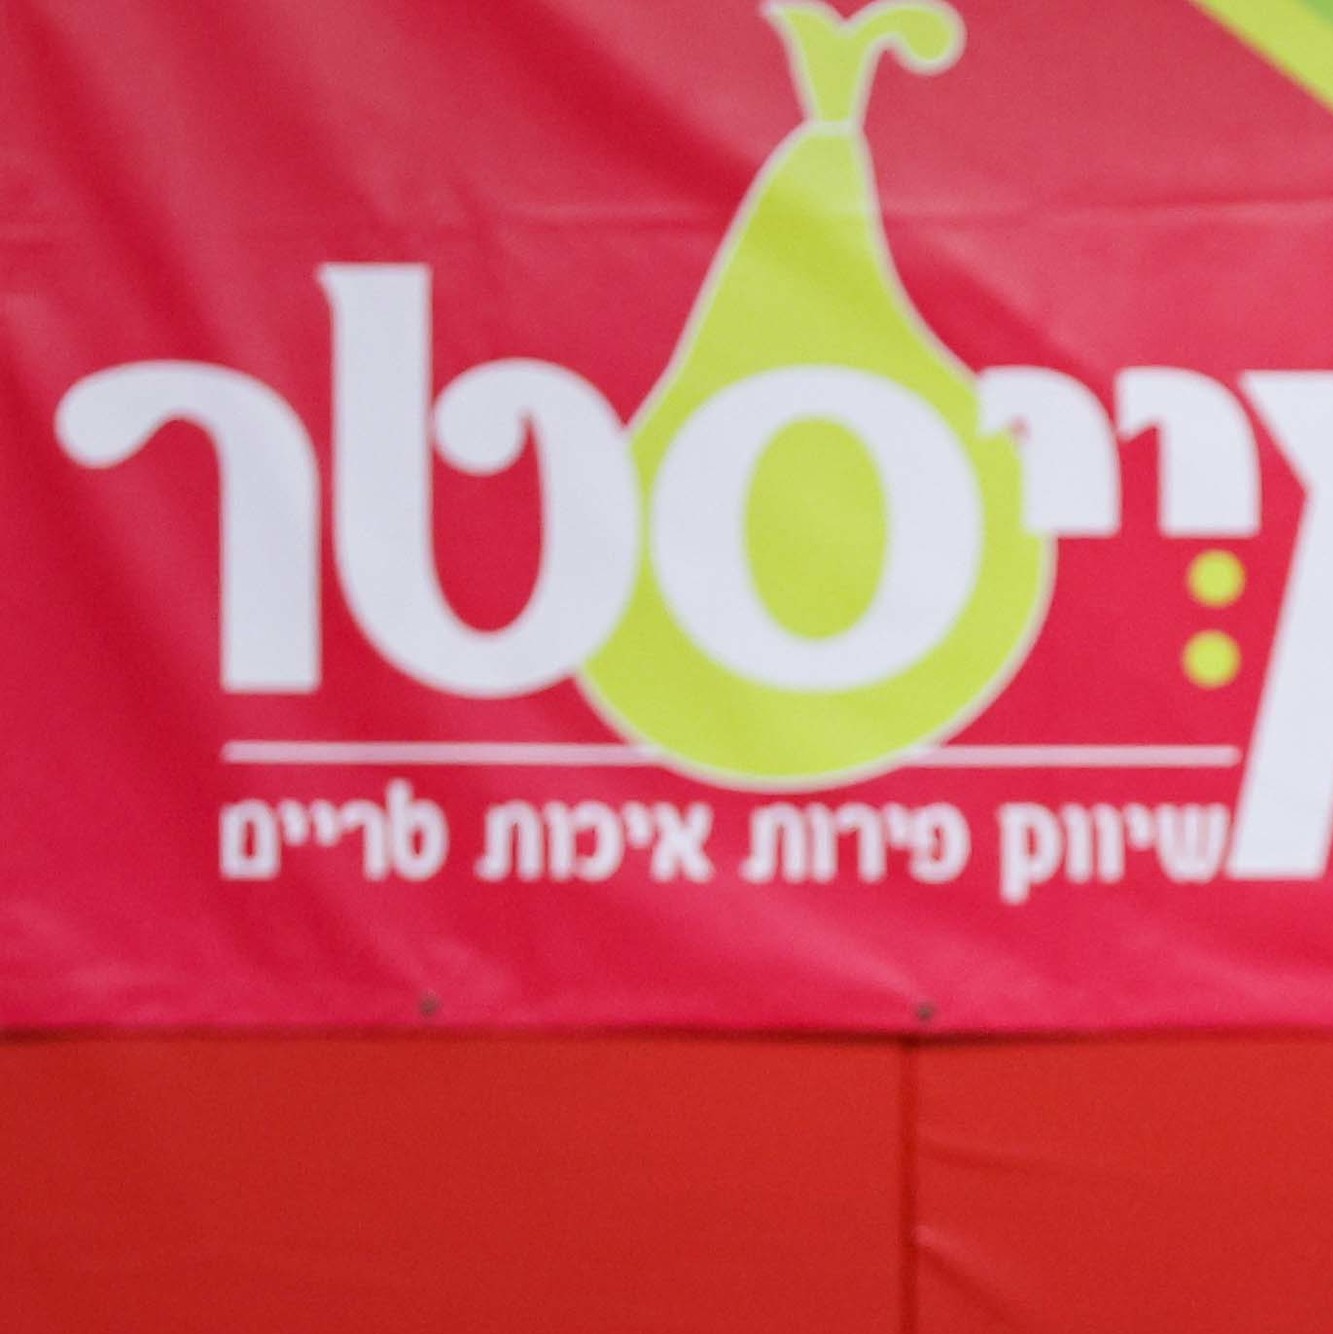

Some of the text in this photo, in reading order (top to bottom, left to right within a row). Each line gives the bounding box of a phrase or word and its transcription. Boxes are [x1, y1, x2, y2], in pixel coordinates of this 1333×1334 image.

[219, 782, 1231, 905] שיווק פירות איכות טריים
